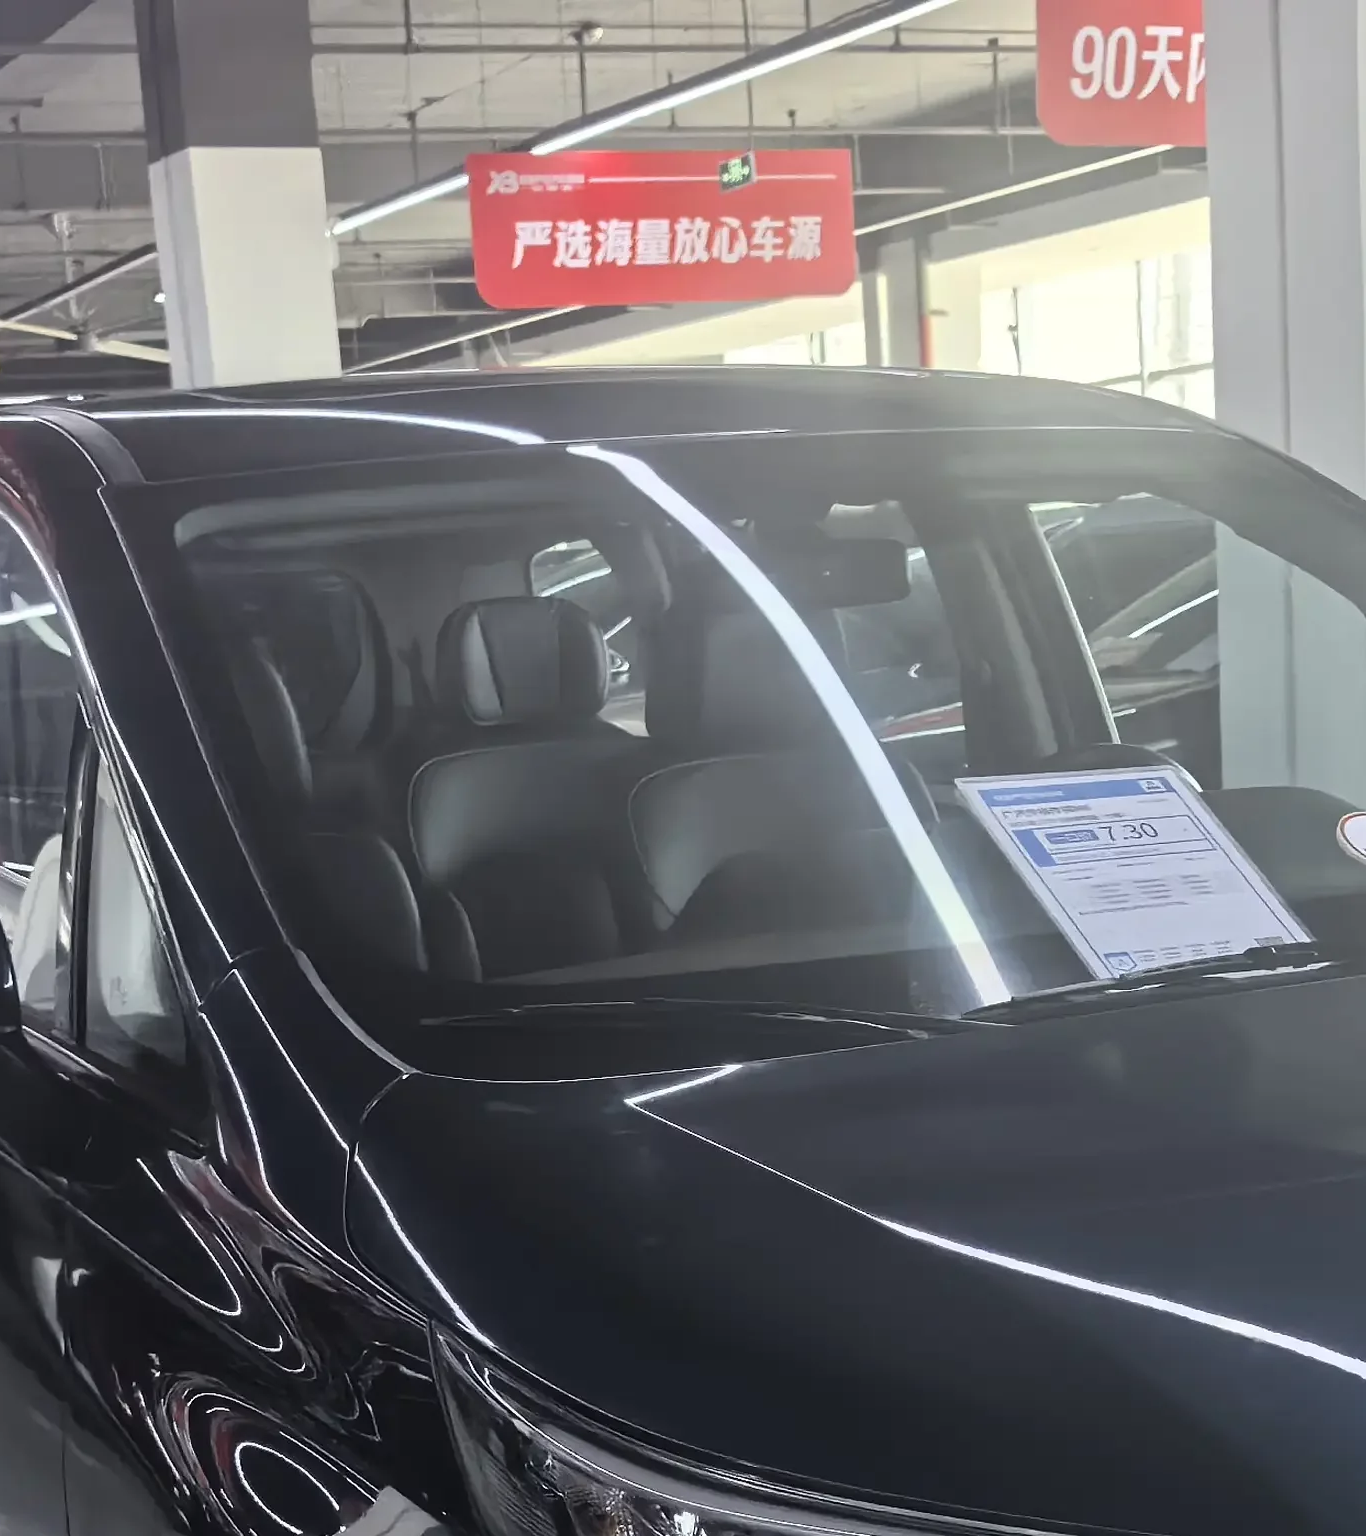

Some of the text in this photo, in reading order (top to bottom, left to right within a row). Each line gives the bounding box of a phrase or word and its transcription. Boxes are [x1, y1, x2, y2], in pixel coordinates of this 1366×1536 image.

[512, 216, 822, 269] 严选海量放心车源
[1098, 822, 1158, 841] 7.30
